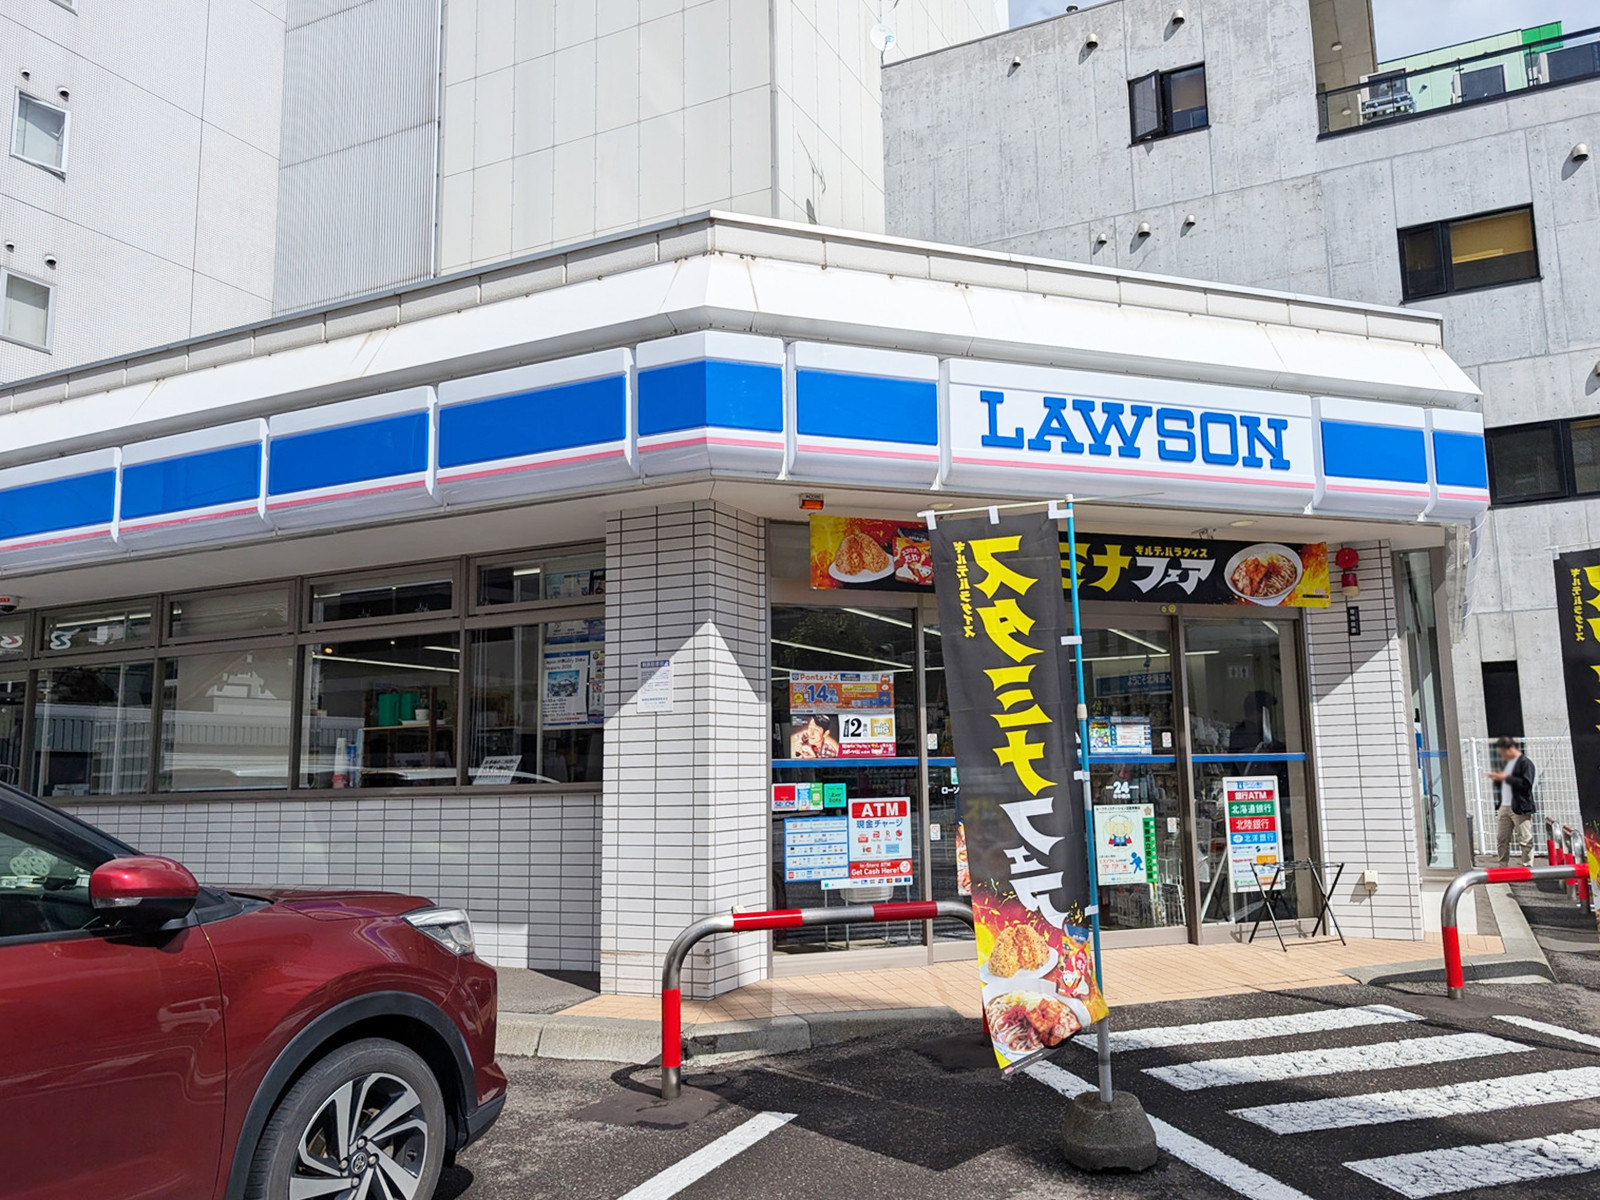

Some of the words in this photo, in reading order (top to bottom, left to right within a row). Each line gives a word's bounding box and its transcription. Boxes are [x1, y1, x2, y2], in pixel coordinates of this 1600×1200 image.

[980, 390, 1290, 471] LAWSON
[1135, 544, 1209, 558] ギルティパラダイス
[1112, 780, 1130, 794] 24
[1234, 791, 1268, 801] 銀行ATM
[861, 802, 899, 818] ATM
[1231, 803, 1272, 815] 北海道銀行
[856, 819, 904, 829] 現金チャージ
[1236, 818, 1270, 831] 北陸銀行
[1244, 833, 1275, 843] 北洋銀行
[881, 866, 900, 875] Here!
